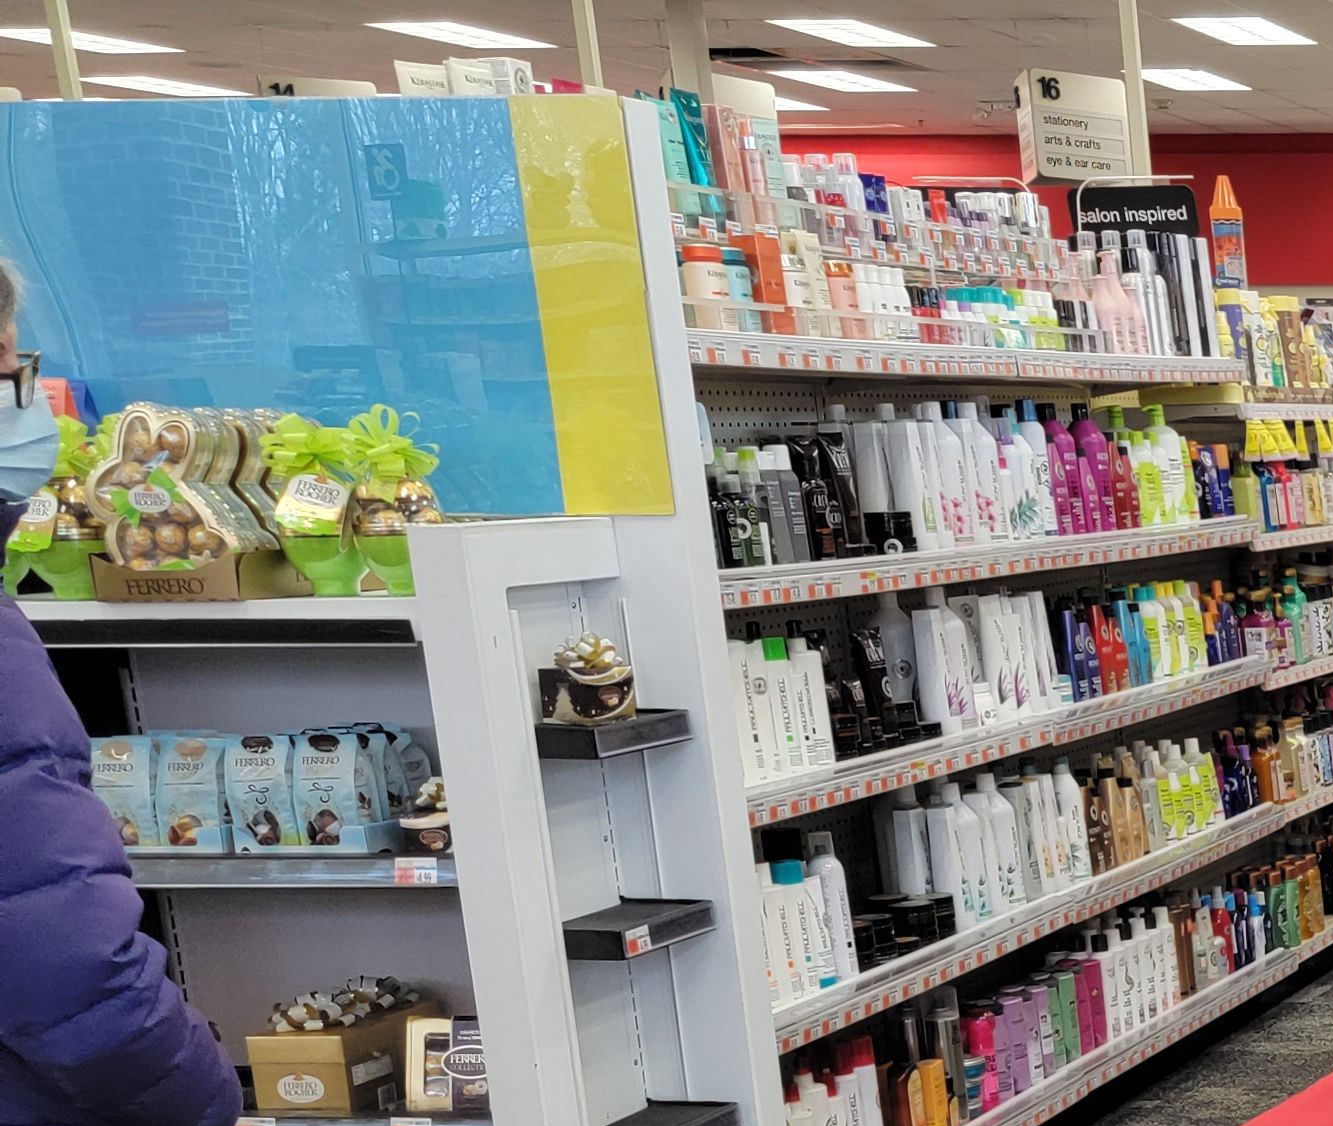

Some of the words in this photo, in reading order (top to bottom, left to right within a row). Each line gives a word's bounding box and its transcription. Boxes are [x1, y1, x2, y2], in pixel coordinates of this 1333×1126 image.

[1037, 76, 1060, 100] 16
[1043, 114, 1089, 130] stationery
[1045, 136, 1062, 145] arts
[1066, 138, 1072, 146] &
[1074, 138, 1101, 150] crafts
[1047, 156, 1062, 166] eye
[1066, 157, 1072, 166] &
[1075, 159, 1089, 168] ear
[1092, 161, 1111, 170] care
[1080, 207, 1120, 223] salon
[1124, 205, 1187, 223] inspired
[297, 478, 340, 499] FERRERO
[125, 577, 205, 596] FERRERO
[235, 757, 275, 768] FERRERO
[302, 756, 340, 767] FERRERO
